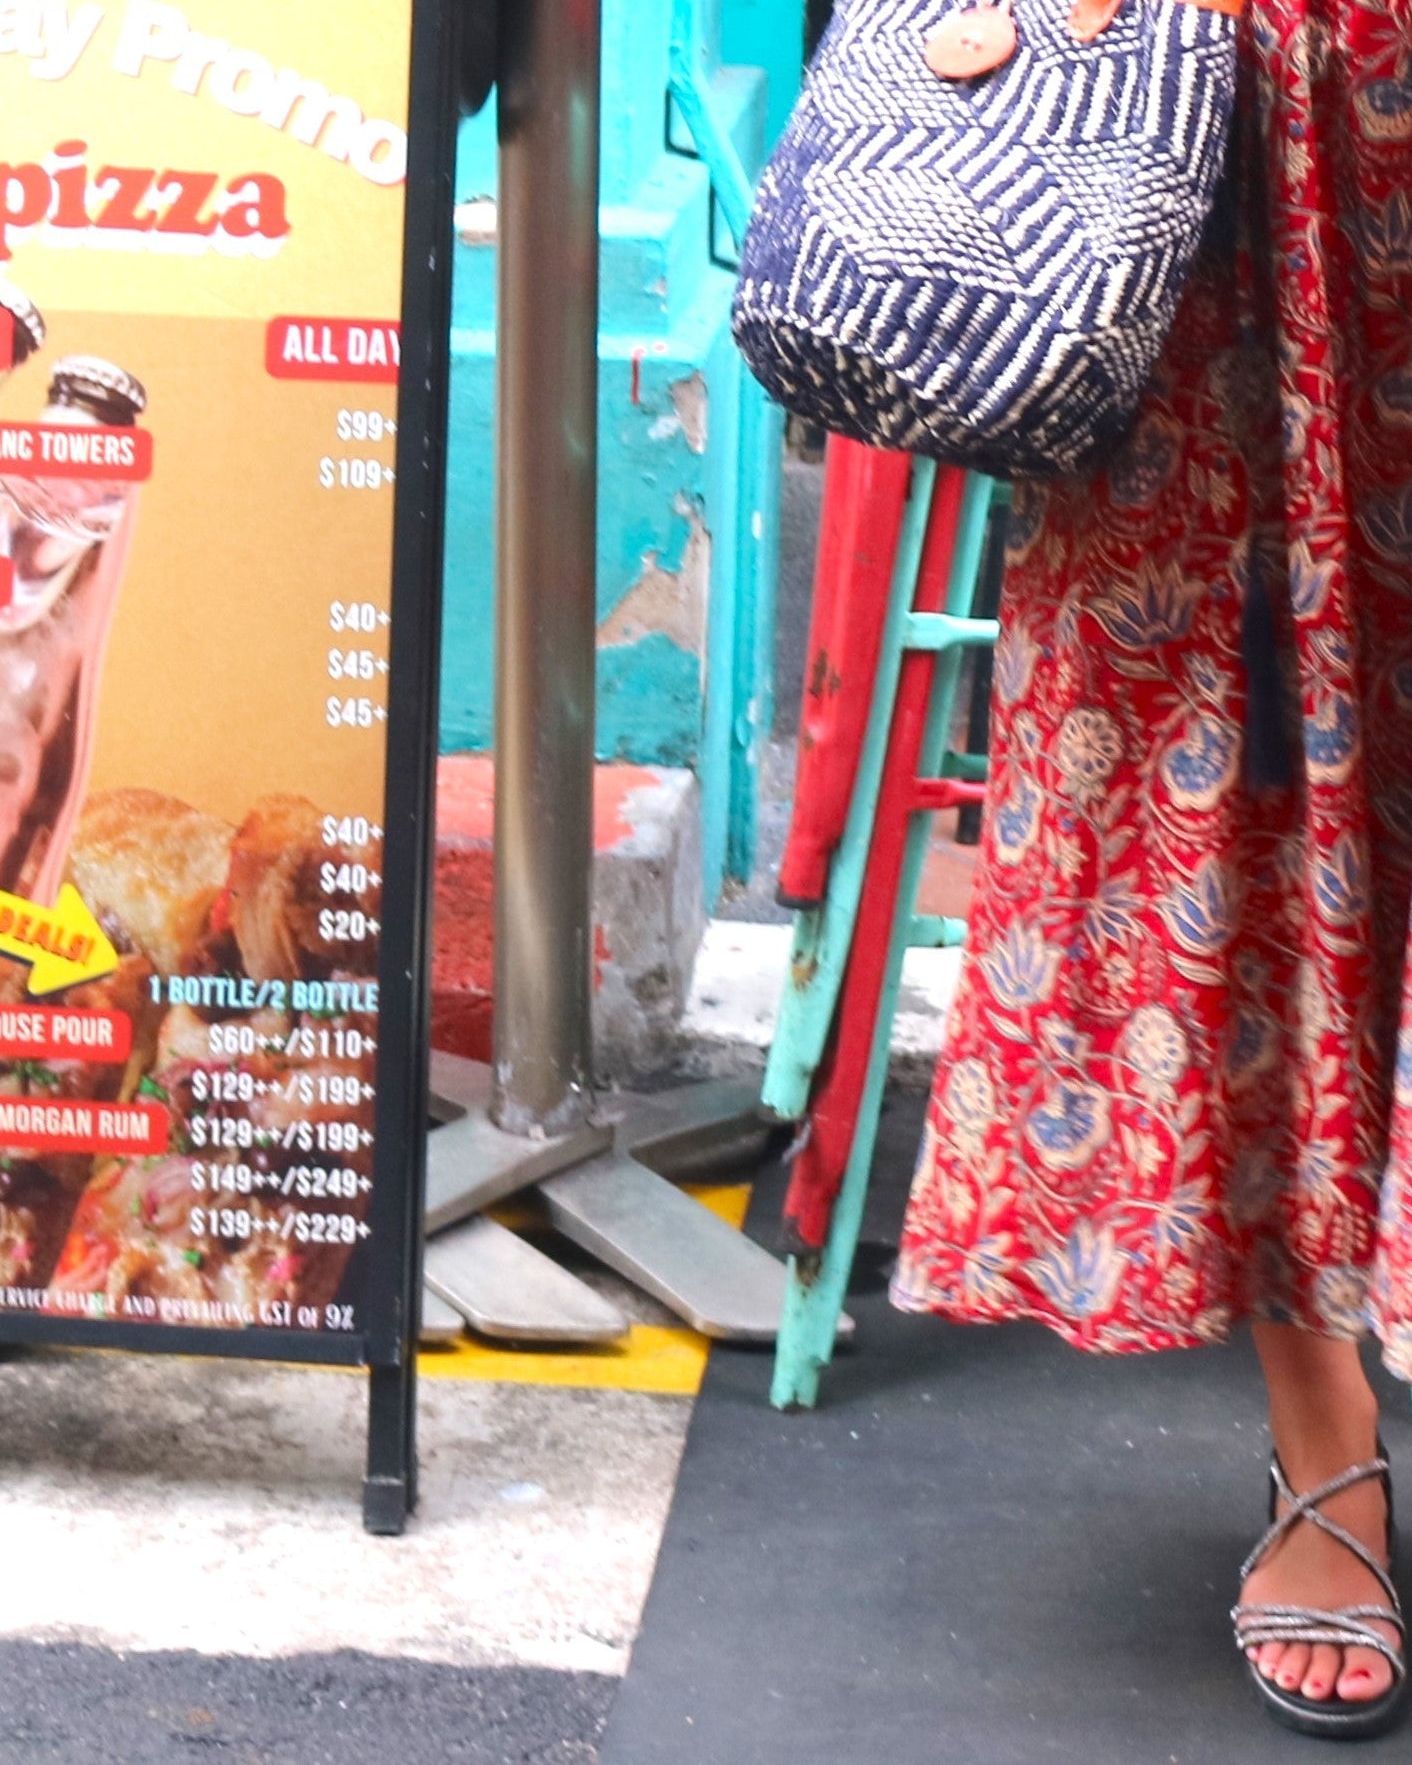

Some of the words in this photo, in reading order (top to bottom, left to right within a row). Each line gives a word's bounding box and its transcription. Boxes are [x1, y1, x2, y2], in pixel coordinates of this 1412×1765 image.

[283, 324, 338, 364] ALL
[38, 430, 136, 468] TOWERS
[292, 980, 380, 1013] BOTTLE
[52, 1014, 113, 1048] POUR
[0, 1103, 93, 1139] MORGAN
[99, 1108, 151, 1142] RUM
